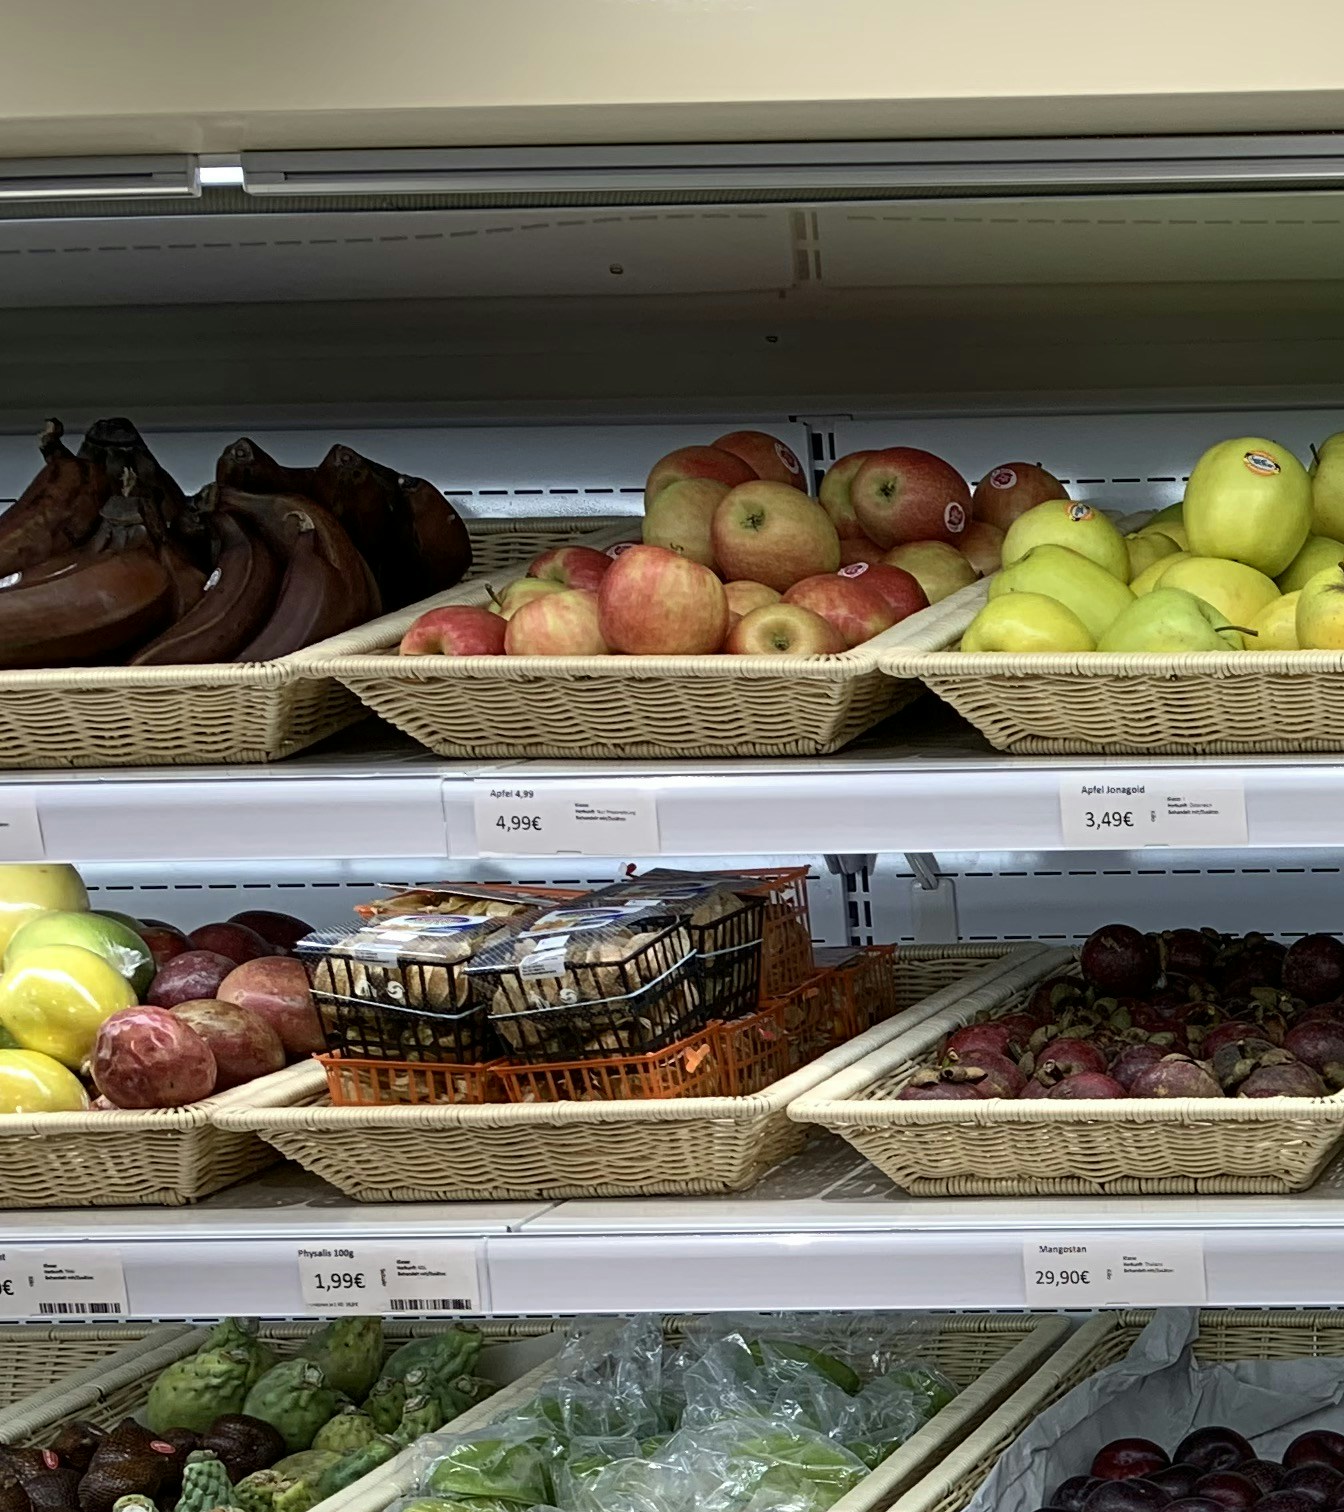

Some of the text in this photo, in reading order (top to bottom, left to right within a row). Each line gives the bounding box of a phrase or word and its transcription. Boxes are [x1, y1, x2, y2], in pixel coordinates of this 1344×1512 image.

[490, 790, 534, 799] Apfel 4,99
[1082, 785, 1145, 795] Apfel Jonagold
[496, 816, 542, 832] 4,99€
[1086, 812, 1134, 829] 3,49€
[298, 1249, 354, 1259] Physalis 100g
[1039, 1246, 1086, 1254] Mangostan
[315, 1273, 365, 1291] 1,99€
[1036, 1271, 1090, 1286] 29,90€
